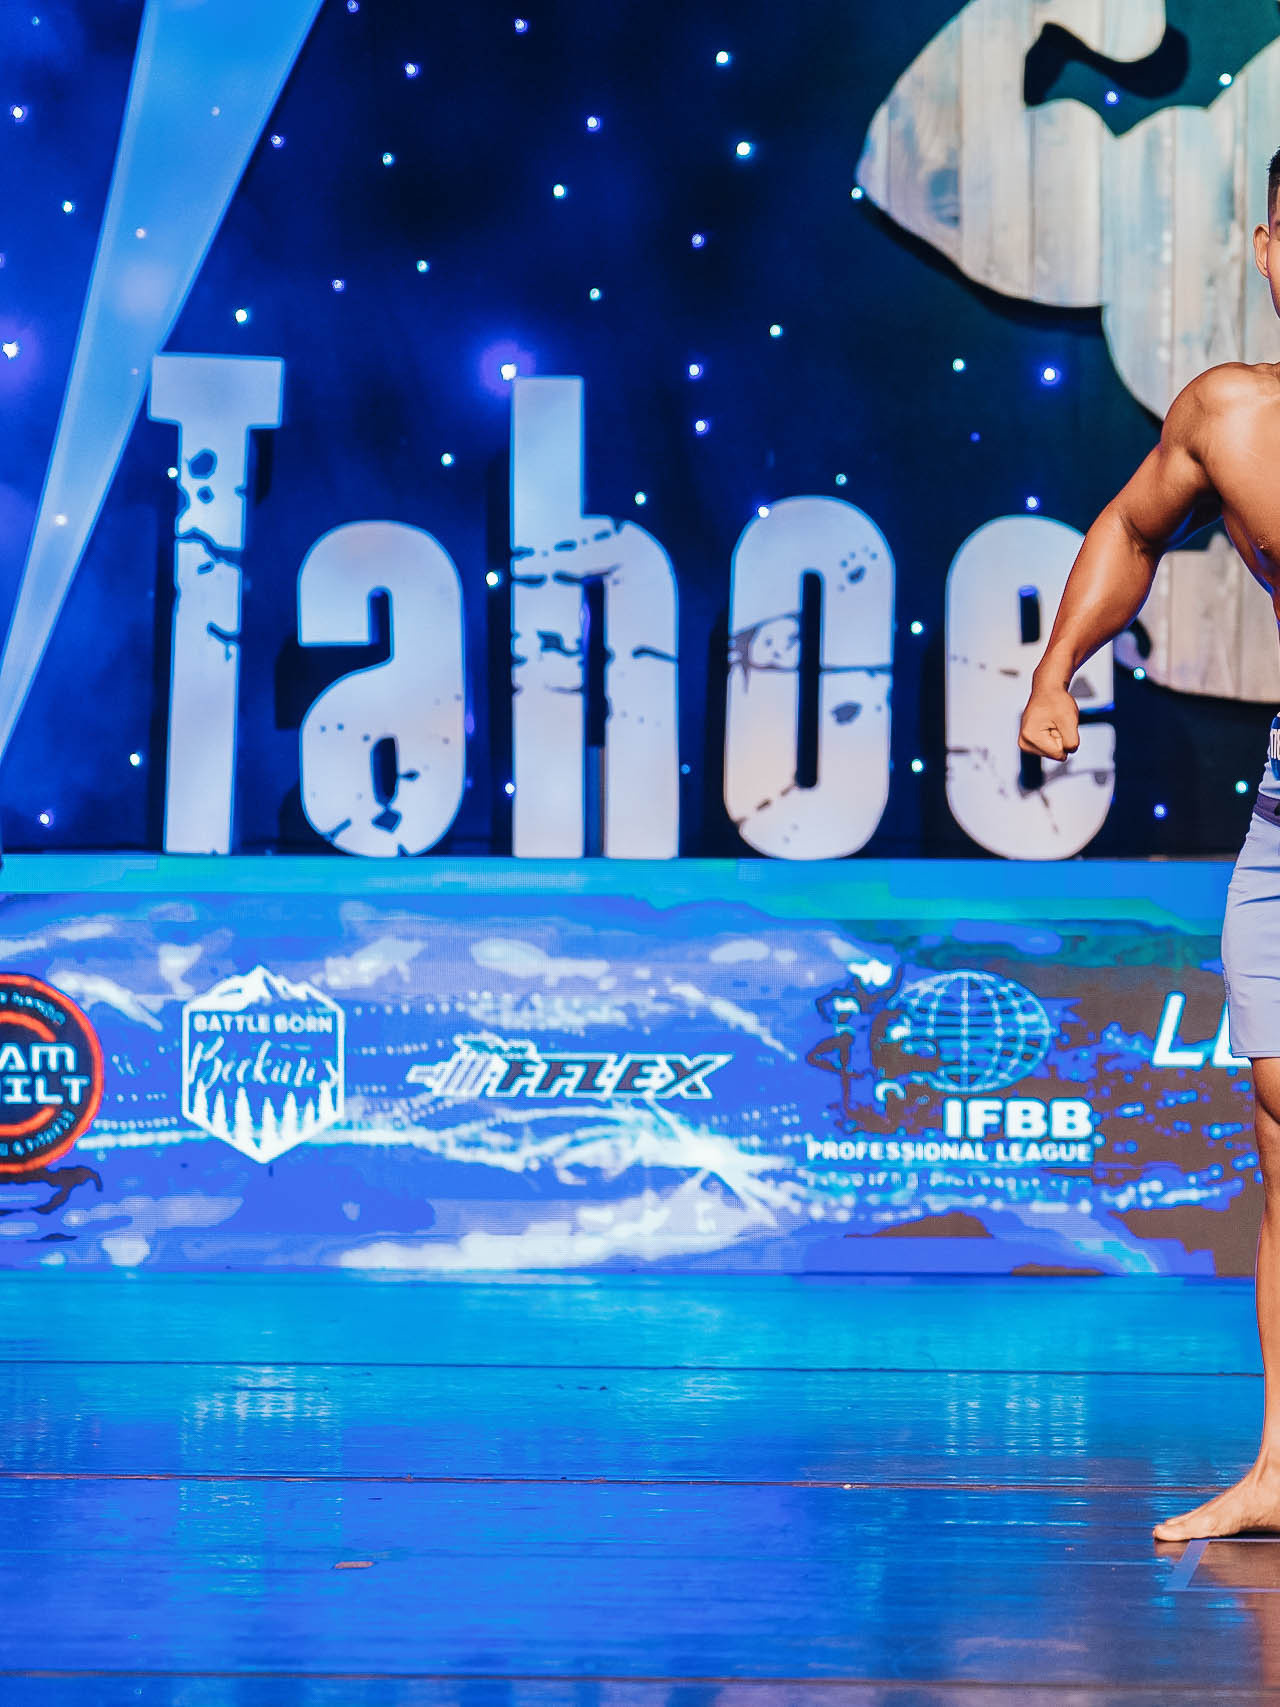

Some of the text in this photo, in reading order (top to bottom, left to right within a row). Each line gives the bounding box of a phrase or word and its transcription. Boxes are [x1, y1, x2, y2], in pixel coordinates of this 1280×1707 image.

[149, 353, 1116, 861] Tahoe
[193, 1013, 333, 1033] BATTLE BORN
[944, 1098, 1093, 1138] IFBB
[806, 1141, 1093, 1162] PROFESSIONAL LEAGUE
